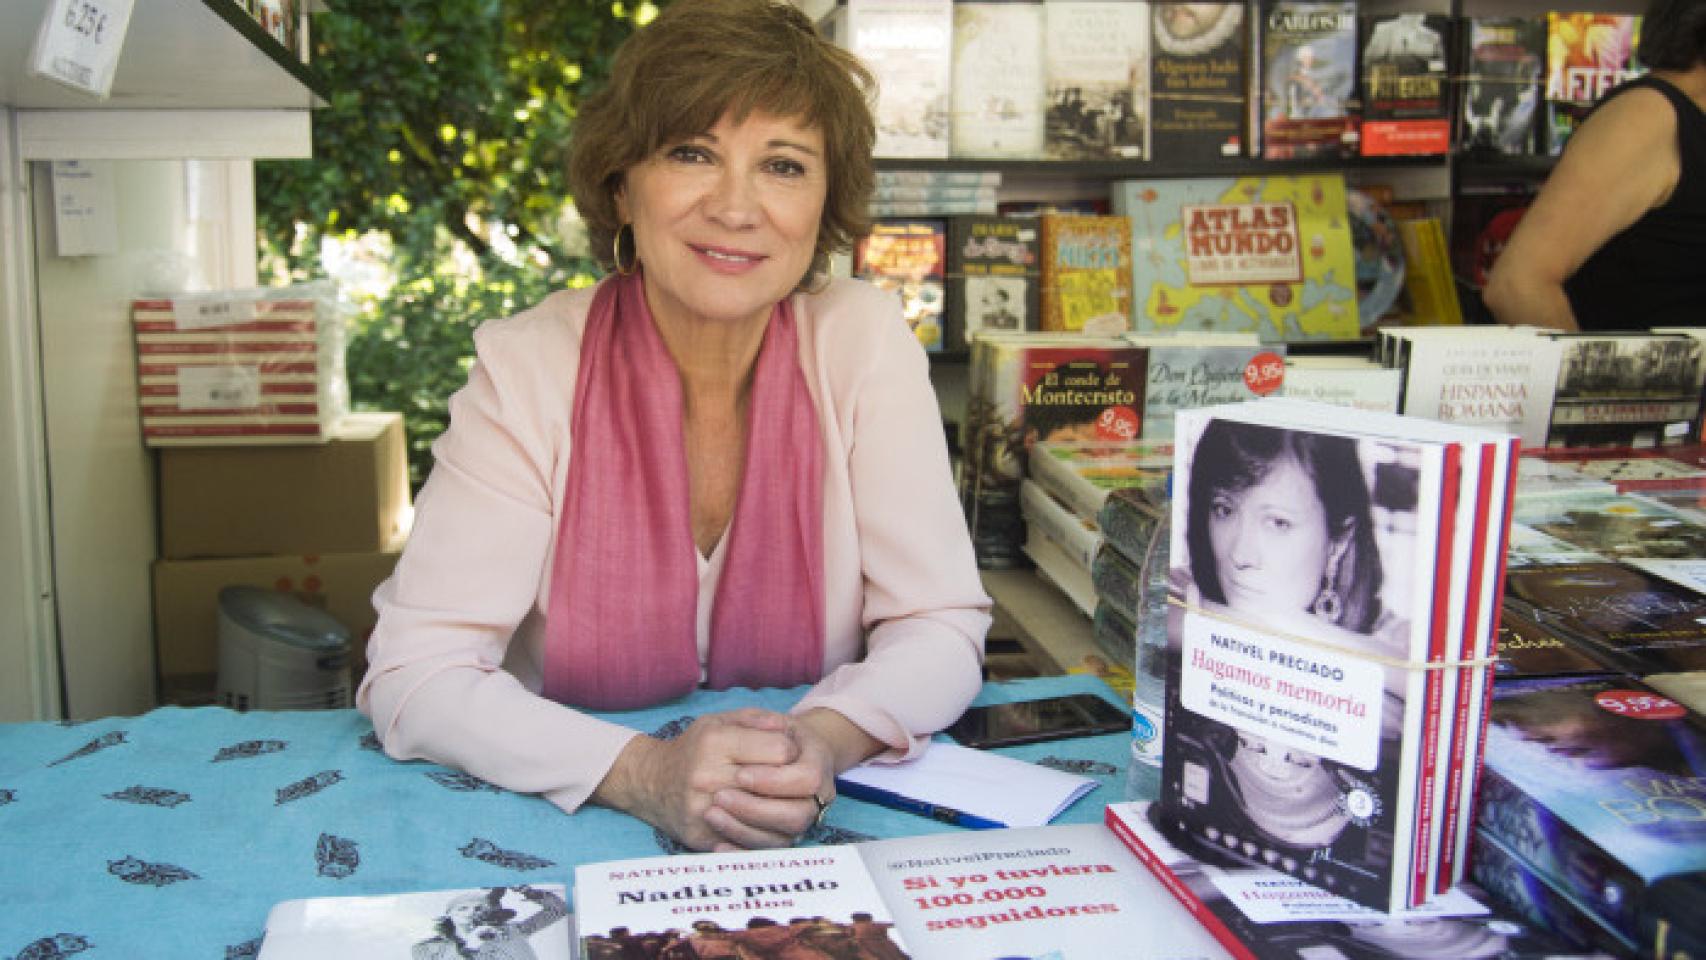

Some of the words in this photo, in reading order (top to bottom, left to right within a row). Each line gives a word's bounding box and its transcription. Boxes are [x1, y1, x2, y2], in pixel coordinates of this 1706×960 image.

[1189, 206, 1288, 233] ATLAS
[1190, 231, 1293, 256] MUNDO
[1045, 372, 1058, 386] El
[1065, 372, 1100, 386] conde
[1105, 372, 1121, 386] de
[1149, 361, 1184, 383] Don
[1020, 383, 1136, 405] Montecristo
[1440, 383, 1528, 400] HISPANIA
[1438, 401, 1523, 420] ROMANA
[1210, 633, 1263, 661] NATIVEL
[1269, 650, 1344, 681] PRECIADO
[1191, 648, 1271, 691] Hagamos
[1276, 679, 1366, 718] memoria
[1269, 706, 1338, 734] periodistas
[609, 865, 712, 881] NATIVEL
[717, 857, 834, 873] PRECIADO
[903, 875, 939, 890] Si
[948, 873, 988, 889] yo
[995, 864, 1116, 880] tuviera
[618, 883, 732, 904] Nadie
[743, 878, 839, 898] pudo
[915, 885, 1046, 910] 100.000
[672, 904, 720, 914] con
[728, 899, 795, 910] ellos
[926, 903, 1120, 931] seguidores
